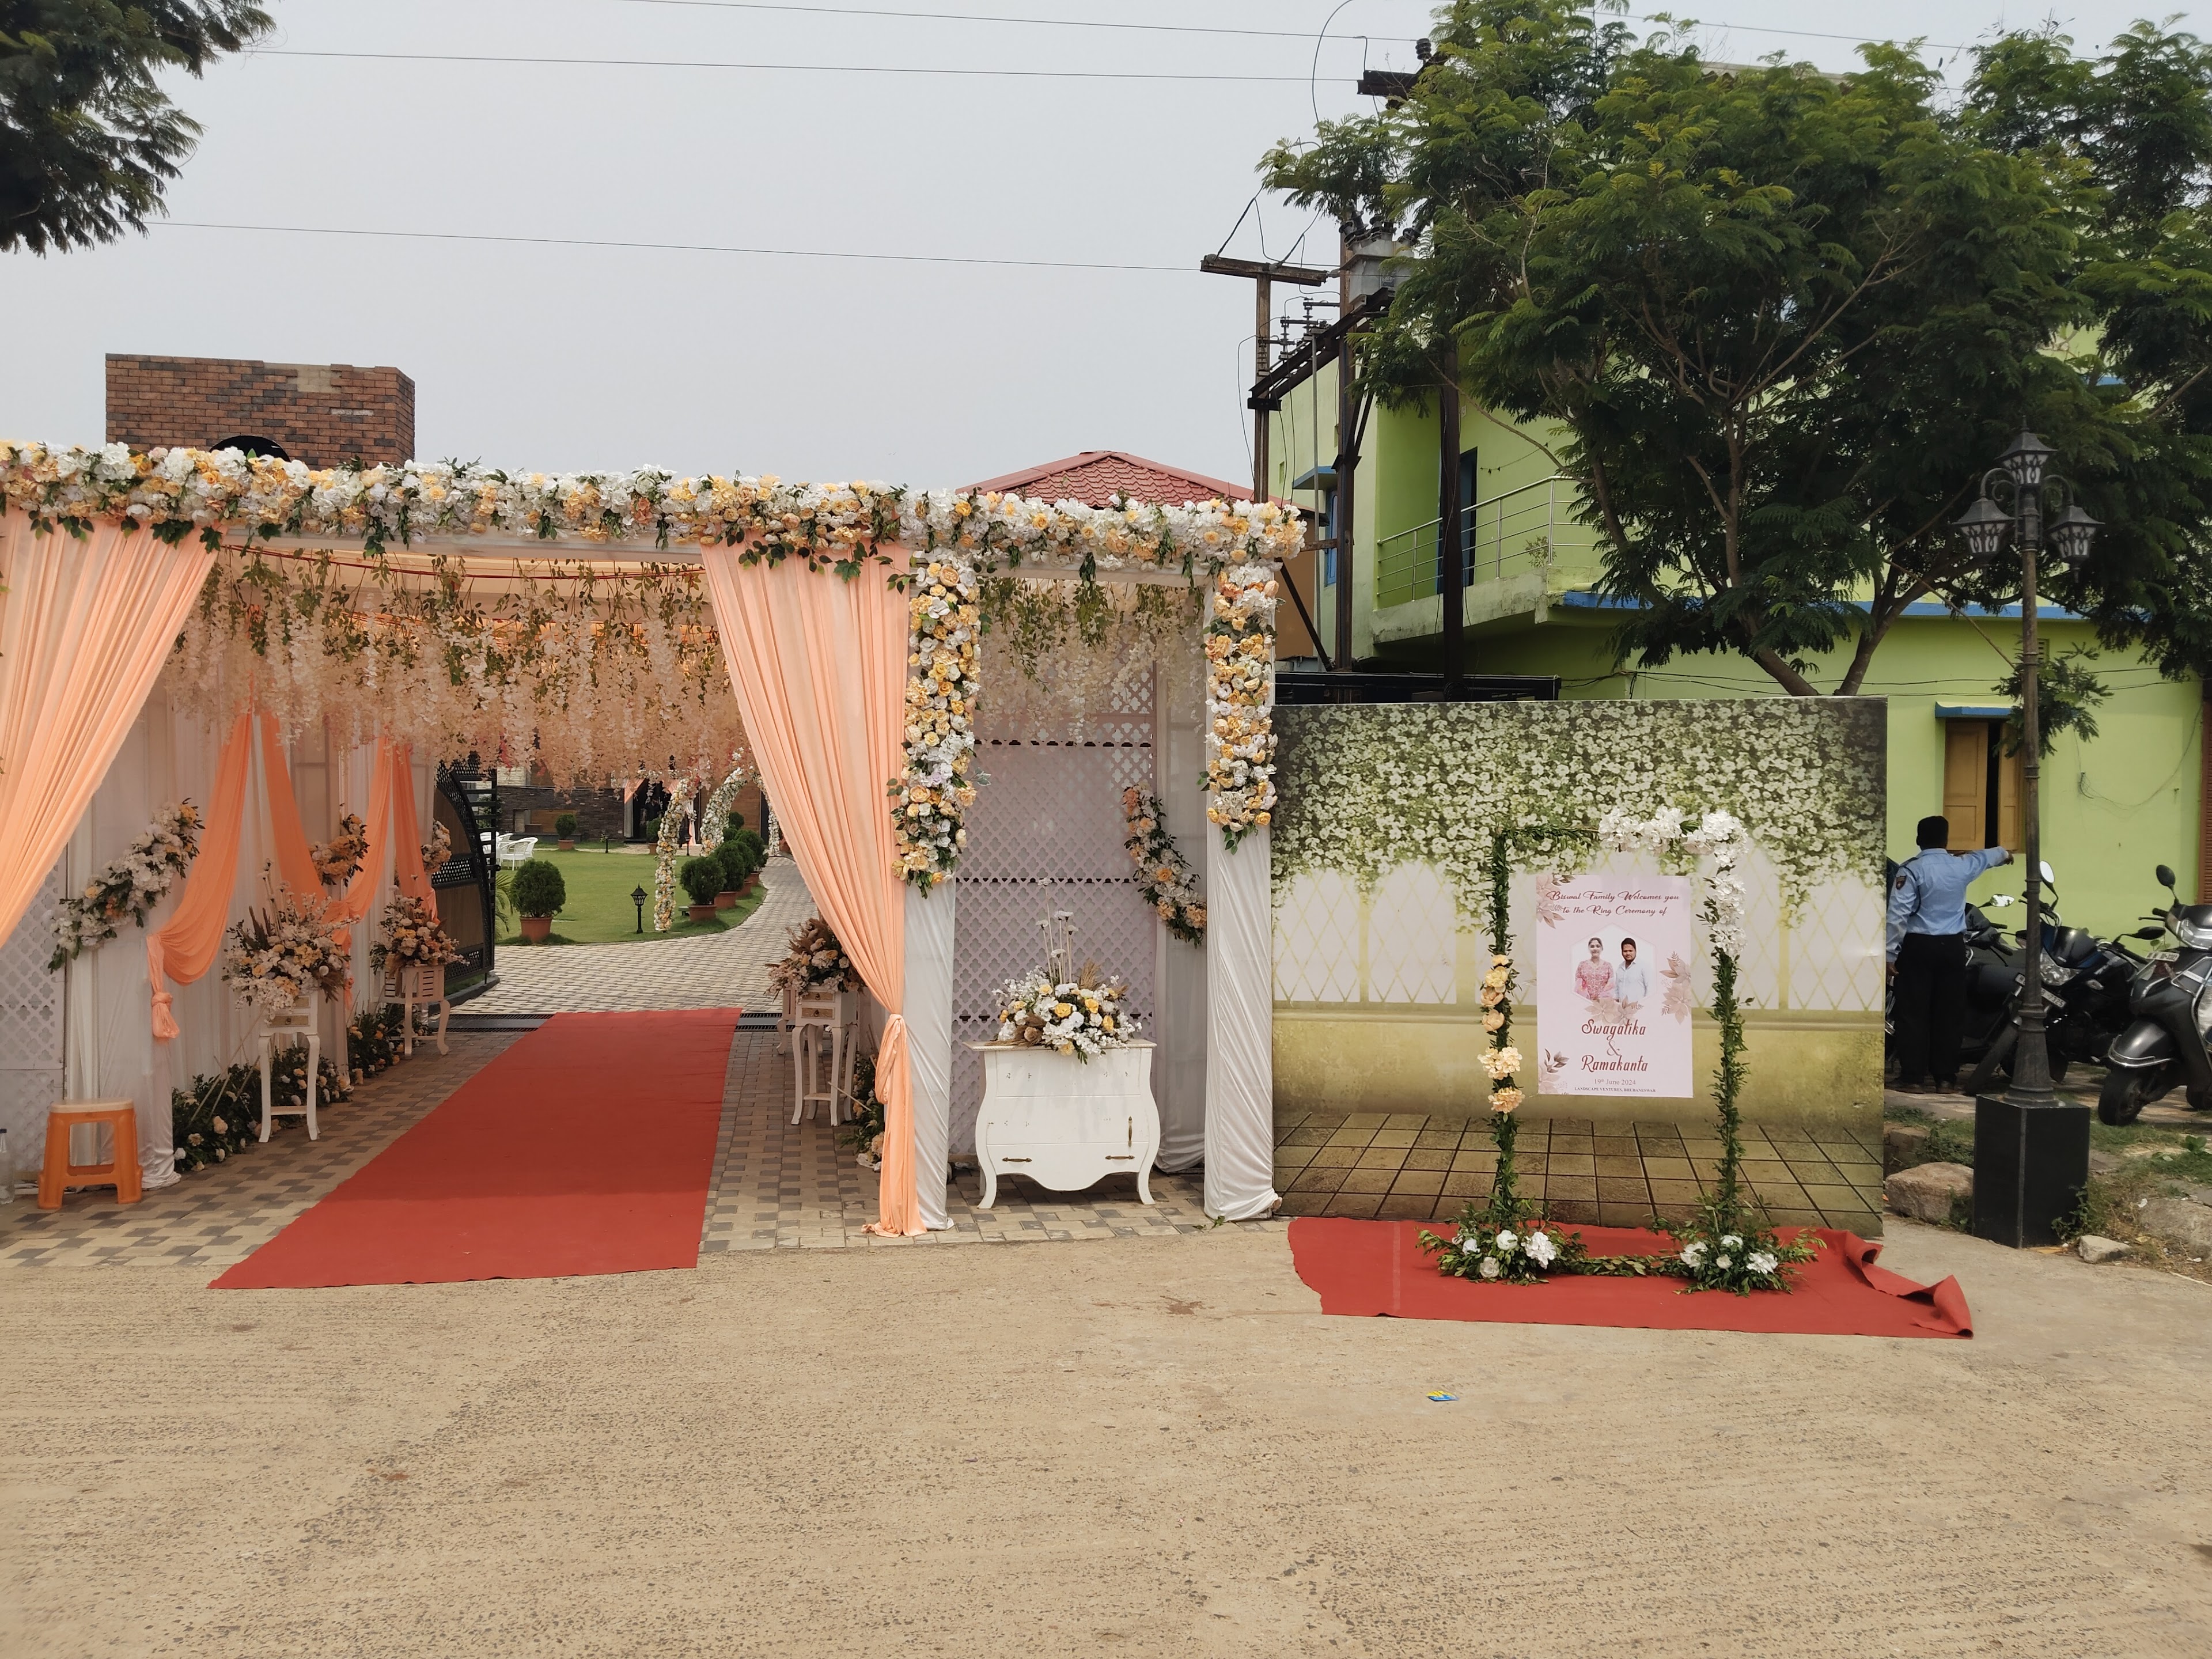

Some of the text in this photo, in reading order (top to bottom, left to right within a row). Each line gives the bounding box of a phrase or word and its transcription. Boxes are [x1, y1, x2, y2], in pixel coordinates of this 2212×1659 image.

[1546, 891, 1581, 900] Biswal
[1583, 891, 1615, 903] Family
[1618, 889, 1662, 901] Welcomes
[1586, 904, 1611, 916] Ring
[1615, 905, 1655, 916] Ceremony
[1659, 907, 1668, 916] of
[1581, 1018, 1646, 1041] Swagatika
[1607, 1040, 1621, 1056] &
[1581, 1054, 1648, 1073] Ramakanta
